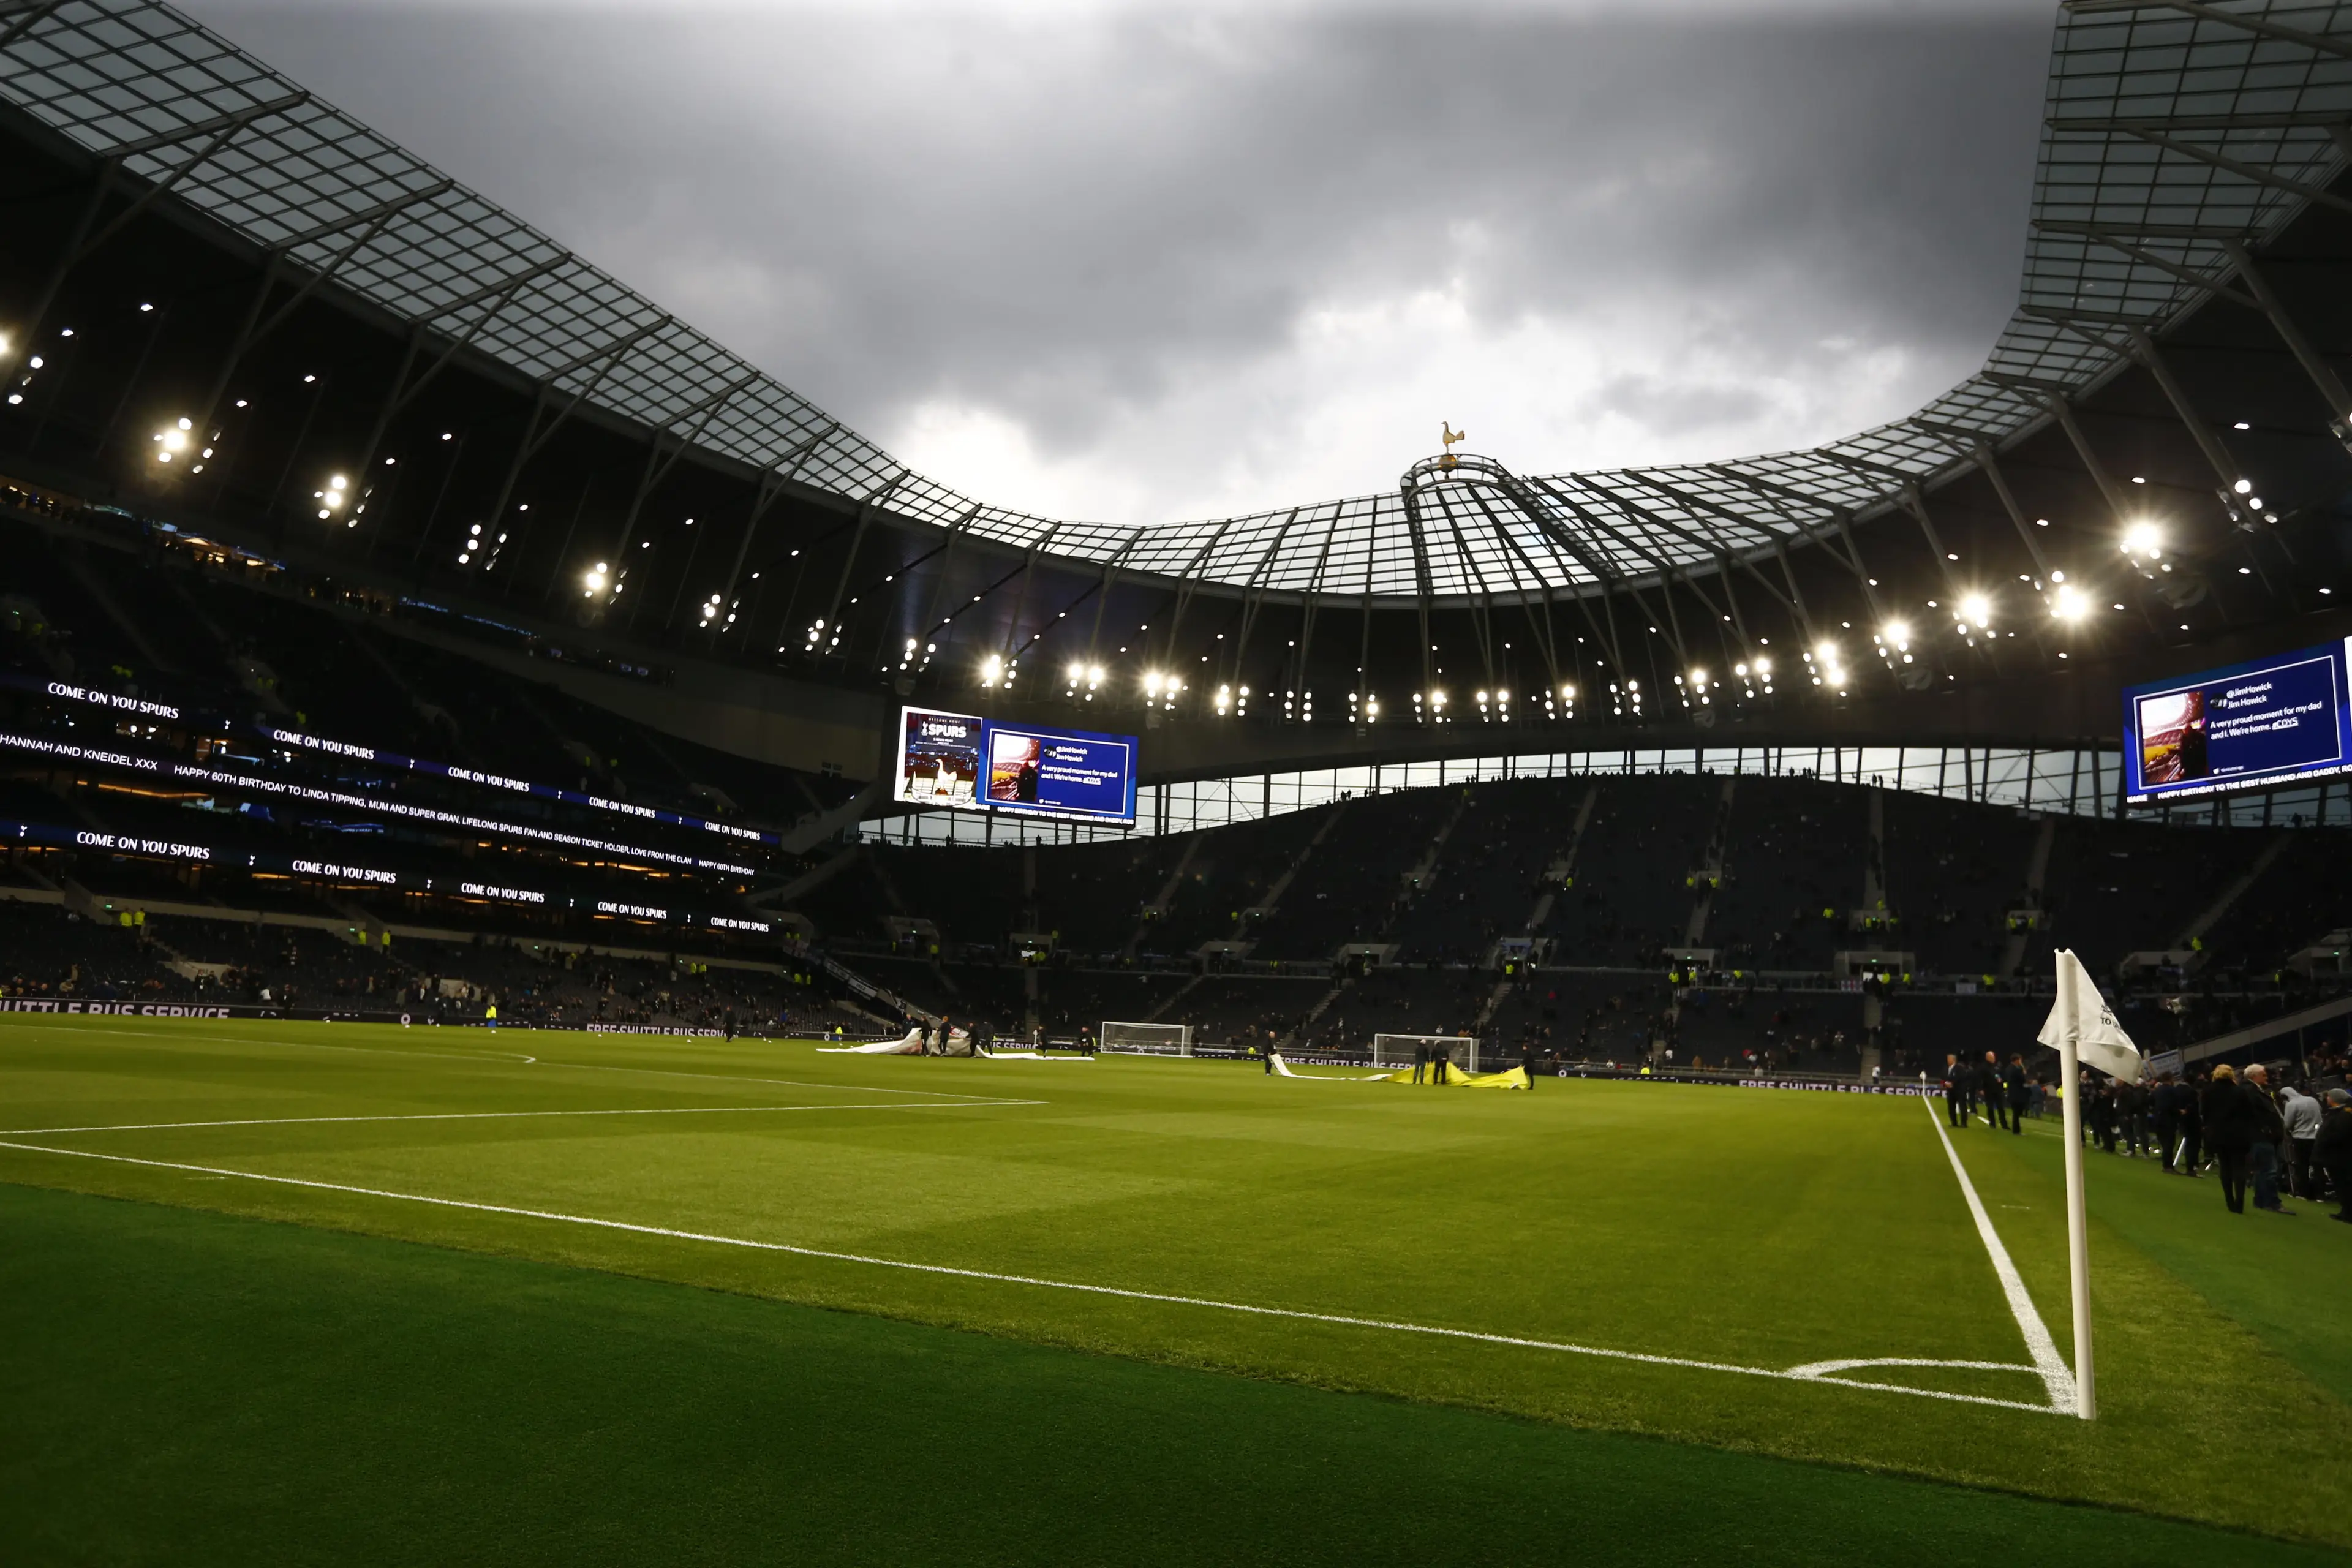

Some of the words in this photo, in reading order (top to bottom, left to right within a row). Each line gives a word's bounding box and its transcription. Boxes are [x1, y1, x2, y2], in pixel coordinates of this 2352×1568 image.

[48, 682, 86, 700] COME
[88, 691, 108, 704] ON
[111, 695, 137, 710] YOU
[139, 701, 179, 719] SPURS
[2226, 682, 2272, 698] @JimHowick
[2241, 695, 2267, 706] Howick
[2216, 719, 2231, 728] very
[2232, 714, 2253, 726] proud
[2253, 710, 2283, 722] moment
[2283, 706, 2294, 716] for
[2296, 705, 2307, 714] my
[2307, 701, 2323, 711] dad
[928, 723, 967, 738] SPURS
[2211, 729, 2224, 740] and
[2229, 727, 2249, 736] We're
[2250, 723, 2271, 733] home.
[273, 729, 303, 745] COME
[304, 736, 320, 748] ON
[322, 739, 342, 753] YOU
[343, 744, 374, 760] SPURS
[448, 766, 472, 780] COME
[472, 772, 485, 783] ON
[486, 774, 503, 786] YOU
[503, 778, 529, 792] SPURS
[2158, 790, 2180, 800] HAPPY
[2180, 785, 2215, 796] BIRTHDAY
[2225, 782, 2240, 790] THE
[2241, 778, 2260, 788] BEST
[2260, 773, 2296, 785] HUSBAND
[2296, 771, 2312, 779] AND
[0, 734, 53, 753] HANNAH
[55, 744, 81, 757] AND
[83, 748, 134, 766] KNEIDEL
[134, 758, 158, 771] XXX
[174, 765, 211, 779] HAPPY
[211, 772, 237, 785] 60TH
[238, 776, 287, 793] BIRTHDAY
[288, 785, 301, 796] TO
[302, 788, 330, 801] LINDA
[331, 793, 367, 809] TIPPING,
[368, 799, 389, 812] MUM
[389, 804, 407, 815] AND
[408, 807, 436, 820] SUPER
[437, 812, 461, 824] GRAN,
[462, 816, 498, 831] LIFELONG
[499, 823, 523, 835] SPURS
[524, 827, 538, 837] FAN
[538, 831, 553, 840] AND
[554, 833, 581, 845] SEASON
[581, 838, 604, 849] TICKET
[604, 842, 631, 854] HOLDER,
[631, 847, 647, 857] LOVE
[647, 850, 665, 860] FROM
[665, 853, 676, 862] THE
[677, 855, 692, 865] CLAN
[698, 859, 717, 869] HAPPY
[730, 865, 755, 876] BIRTHDAY
[589, 796, 608, 809] COME
[609, 801, 620, 811] ON
[620, 803, 635, 814] YOU
[634, 806, 655, 819] SPURS
[704, 821, 721, 832] COME
[721, 825, 730, 834] ON
[731, 826, 743, 837] YOU
[742, 829, 761, 841] SPURS
[77, 831, 115, 848] COME
[118, 837, 138, 850] ON
[141, 839, 168, 854] YOU
[170, 843, 210, 859] SPURS
[292, 860, 323, 874] COME
[324, 864, 340, 876] ON
[342, 866, 363, 880] YOU
[364, 869, 396, 884] SPURS
[461, 883, 485, 895] COME
[486, 886, 499, 897] ON
[501, 888, 518, 900] YOU
[518, 890, 545, 903] SPURS
[597, 901, 618, 913] COME
[619, 904, 630, 914] ON
[631, 905, 645, 916] YOU
[645, 908, 667, 919] SPURS
[710, 916, 728, 927] COME
[728, 919, 737, 929] ON
[738, 920, 750, 930] YOU
[750, 922, 769, 932] SPURS
[0, 1000, 82, 1014] UTTLE
